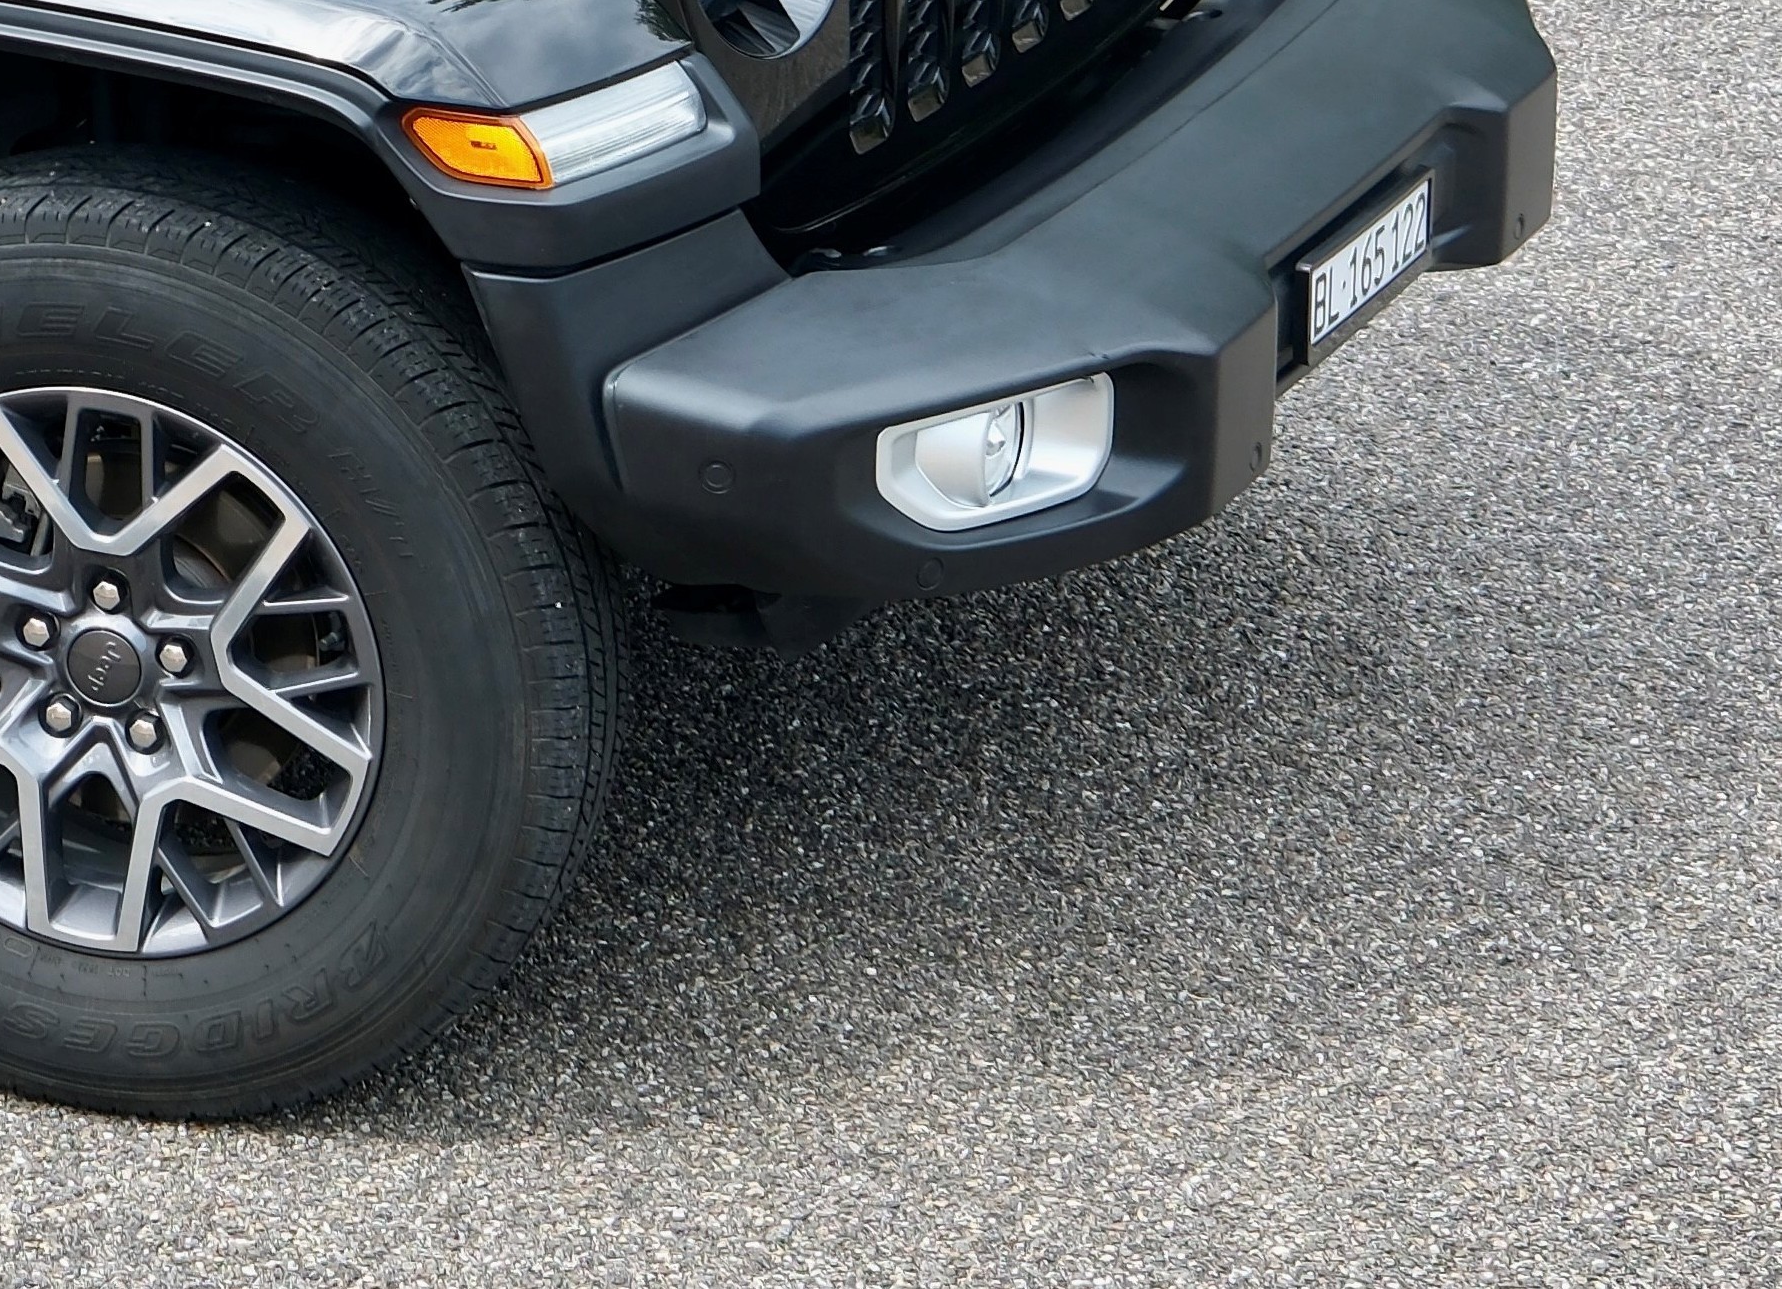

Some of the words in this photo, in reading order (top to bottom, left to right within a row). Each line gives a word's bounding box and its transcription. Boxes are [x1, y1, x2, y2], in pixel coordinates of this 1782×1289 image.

[1349, 224, 1386, 308] 165
[1391, 191, 1426, 272] 122
[87, 640, 121, 692] Jeep
